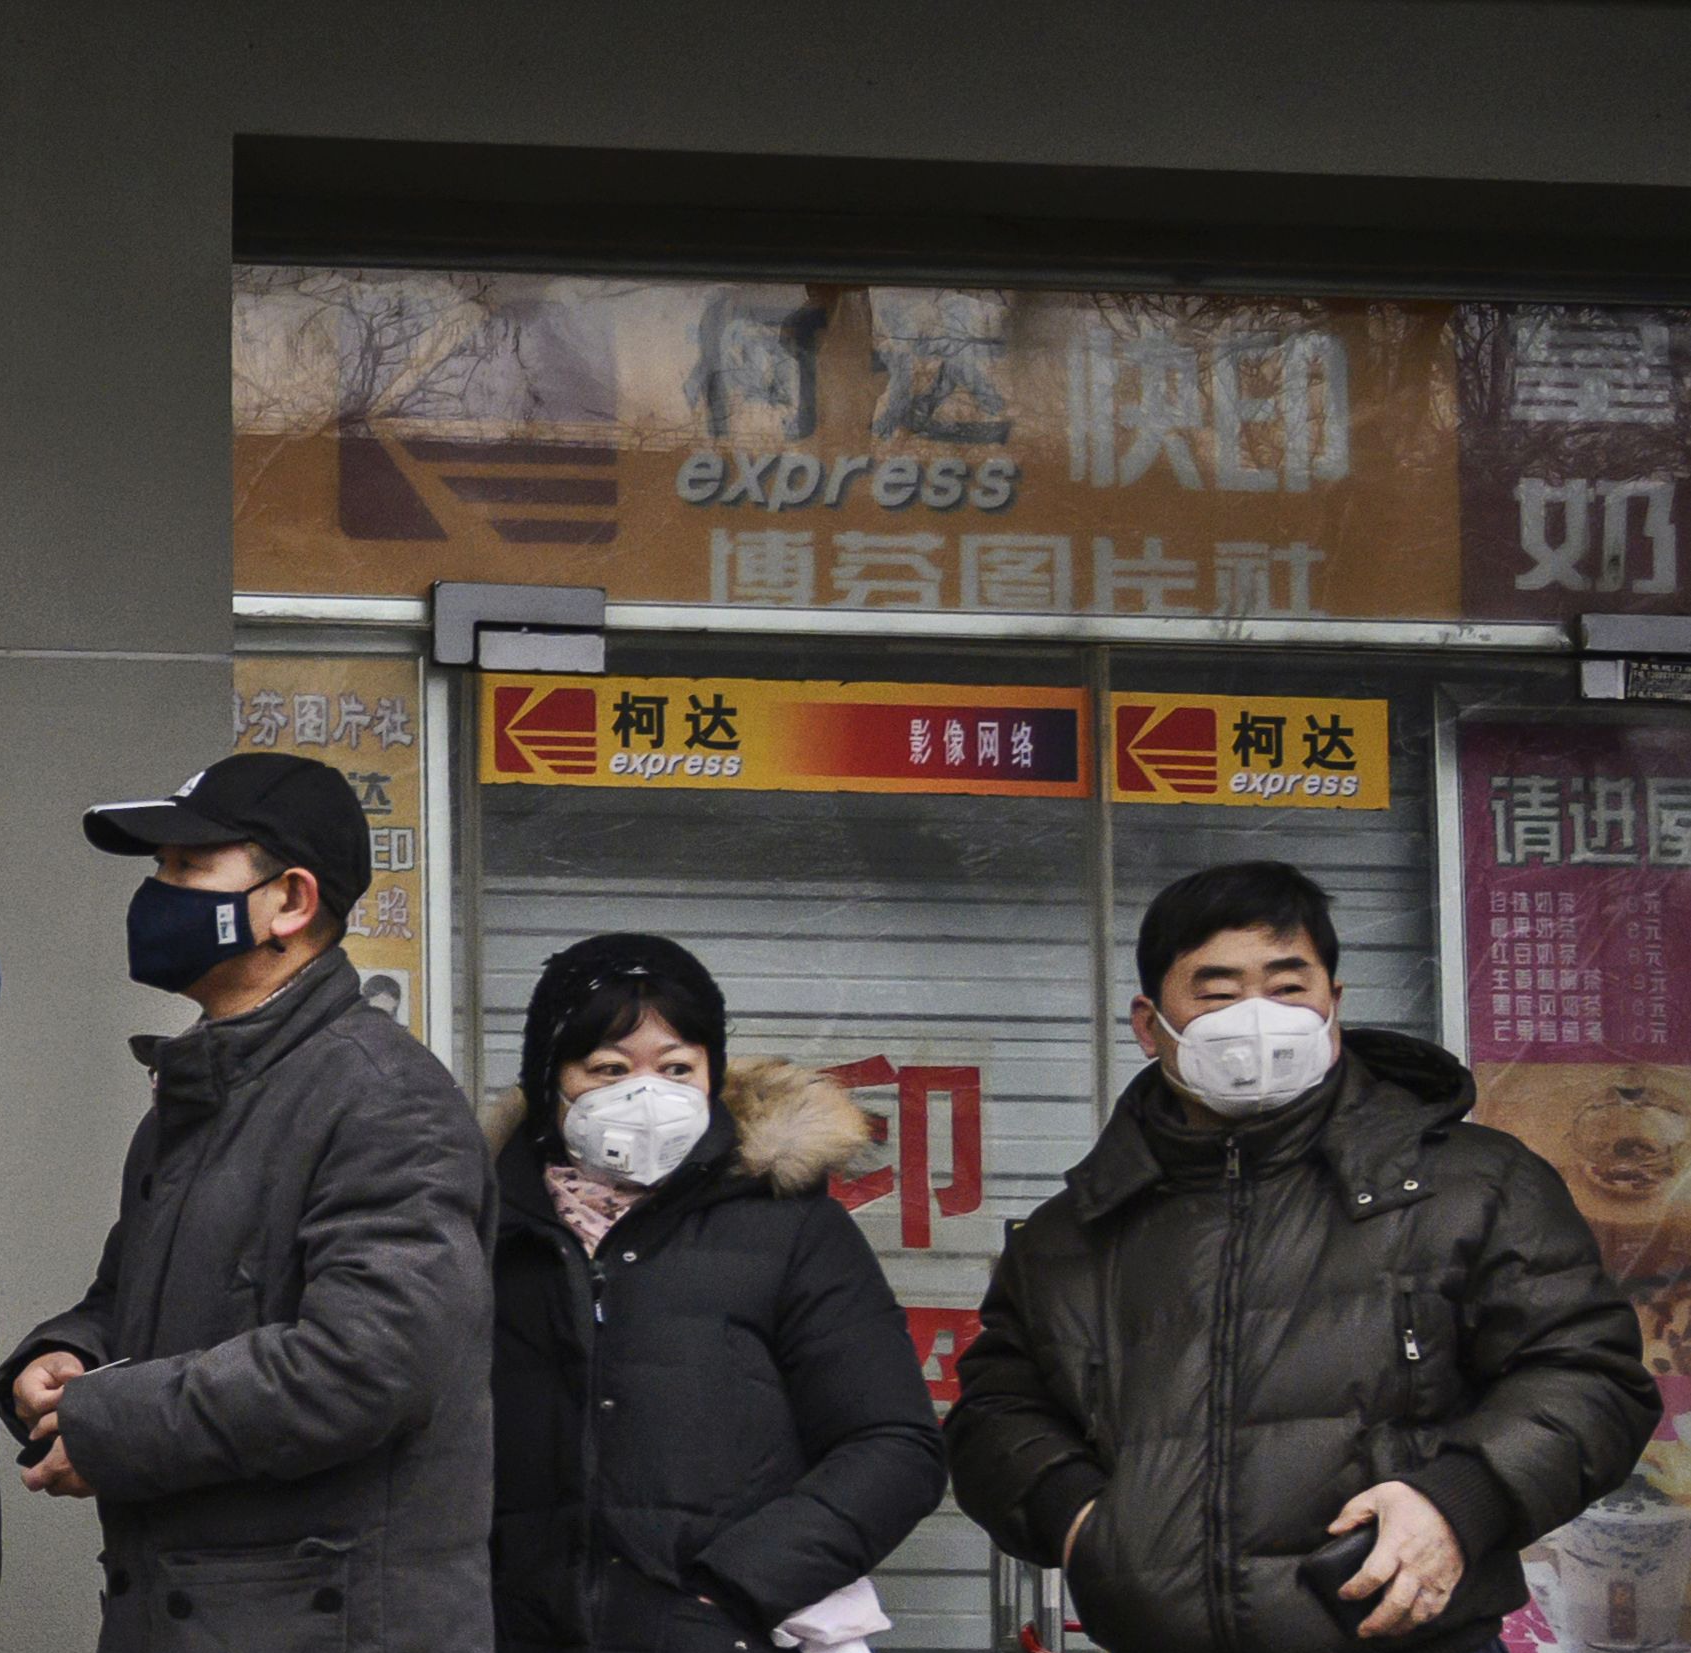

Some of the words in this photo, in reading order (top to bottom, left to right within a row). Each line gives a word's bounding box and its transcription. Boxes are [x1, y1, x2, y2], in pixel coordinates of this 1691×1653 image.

[1066, 326, 1350, 491] 快印
[674, 448, 1021, 513] express
[612, 691, 741, 751] 柯达
[908, 718, 1034, 769] 影像网络
[1231, 711, 1358, 772] 柯达
[608, 751, 744, 779] express
[1228, 770, 1359, 800] express
